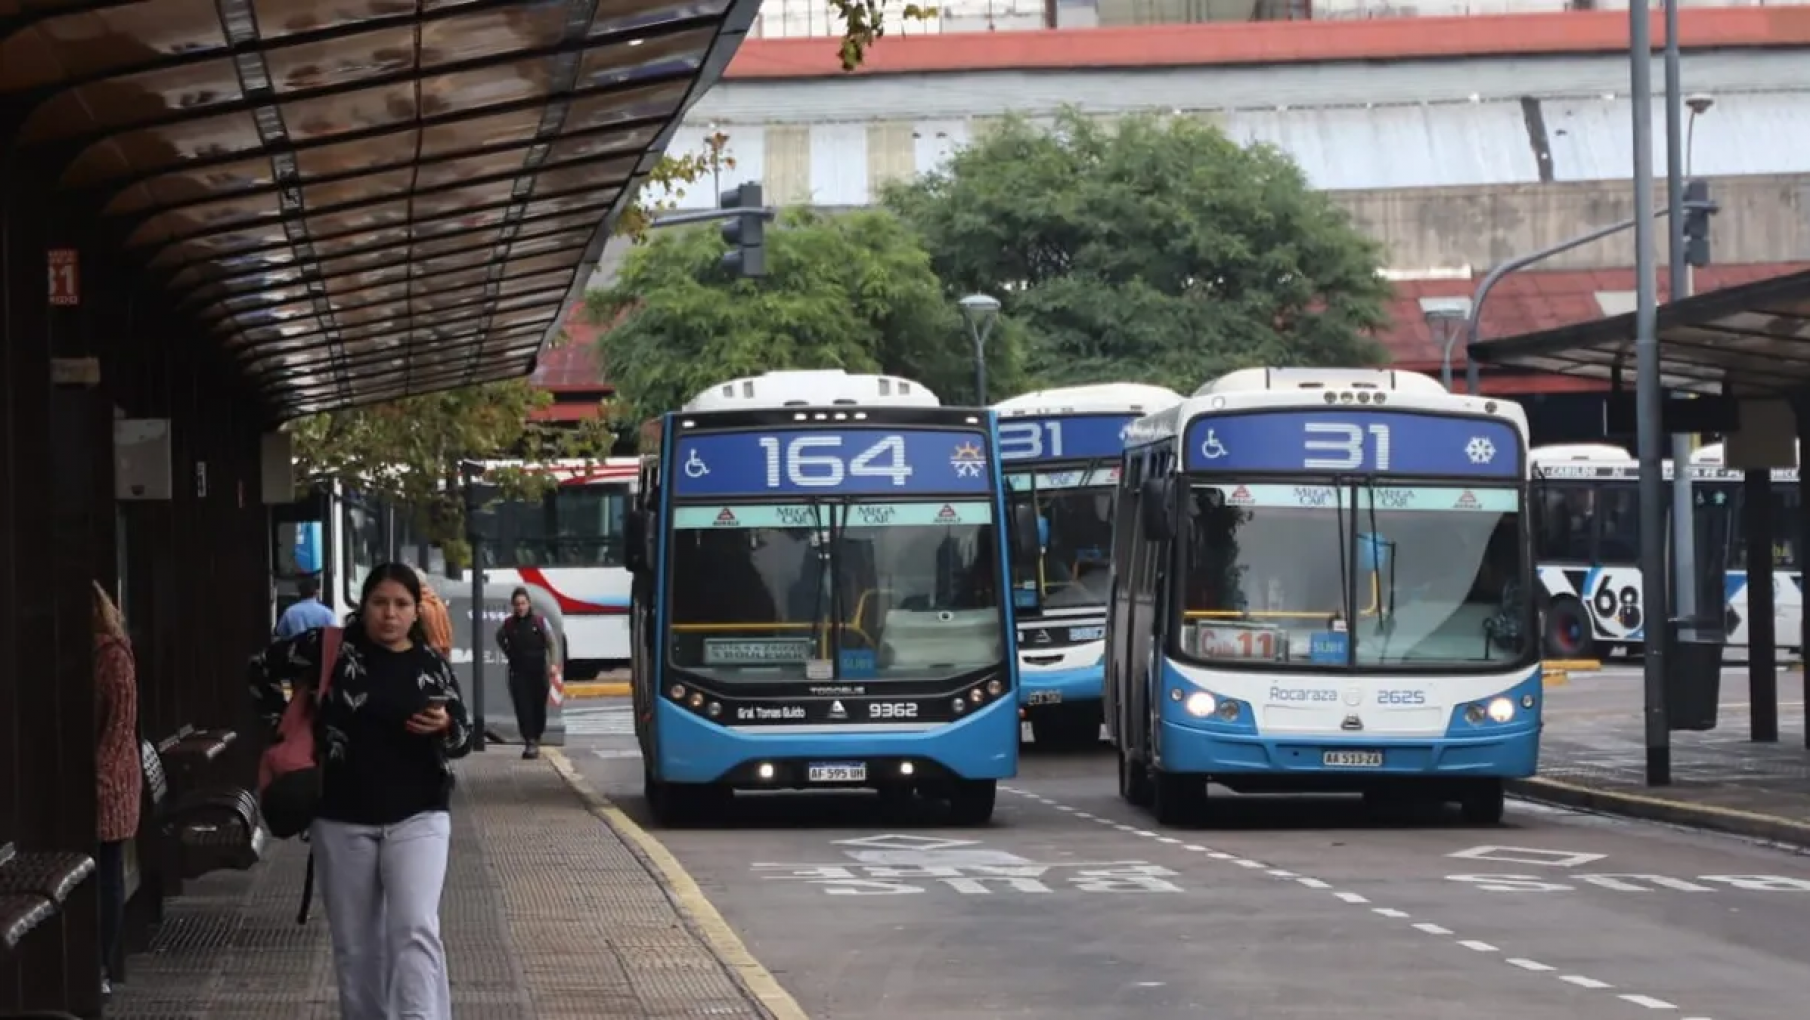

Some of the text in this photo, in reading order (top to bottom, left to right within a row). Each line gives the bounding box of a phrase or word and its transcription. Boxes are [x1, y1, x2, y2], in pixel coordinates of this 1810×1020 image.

[997, 421, 1063, 458] 31
[1303, 421, 1391, 470] 31
[758, 435, 913, 488] 164
[1595, 575, 1642, 629] 68
[1237, 631, 1274, 659] 11
[1269, 686, 1338, 702] Rocaraza
[1377, 690, 1426, 704] 2625
[869, 703, 918, 718] 9362
